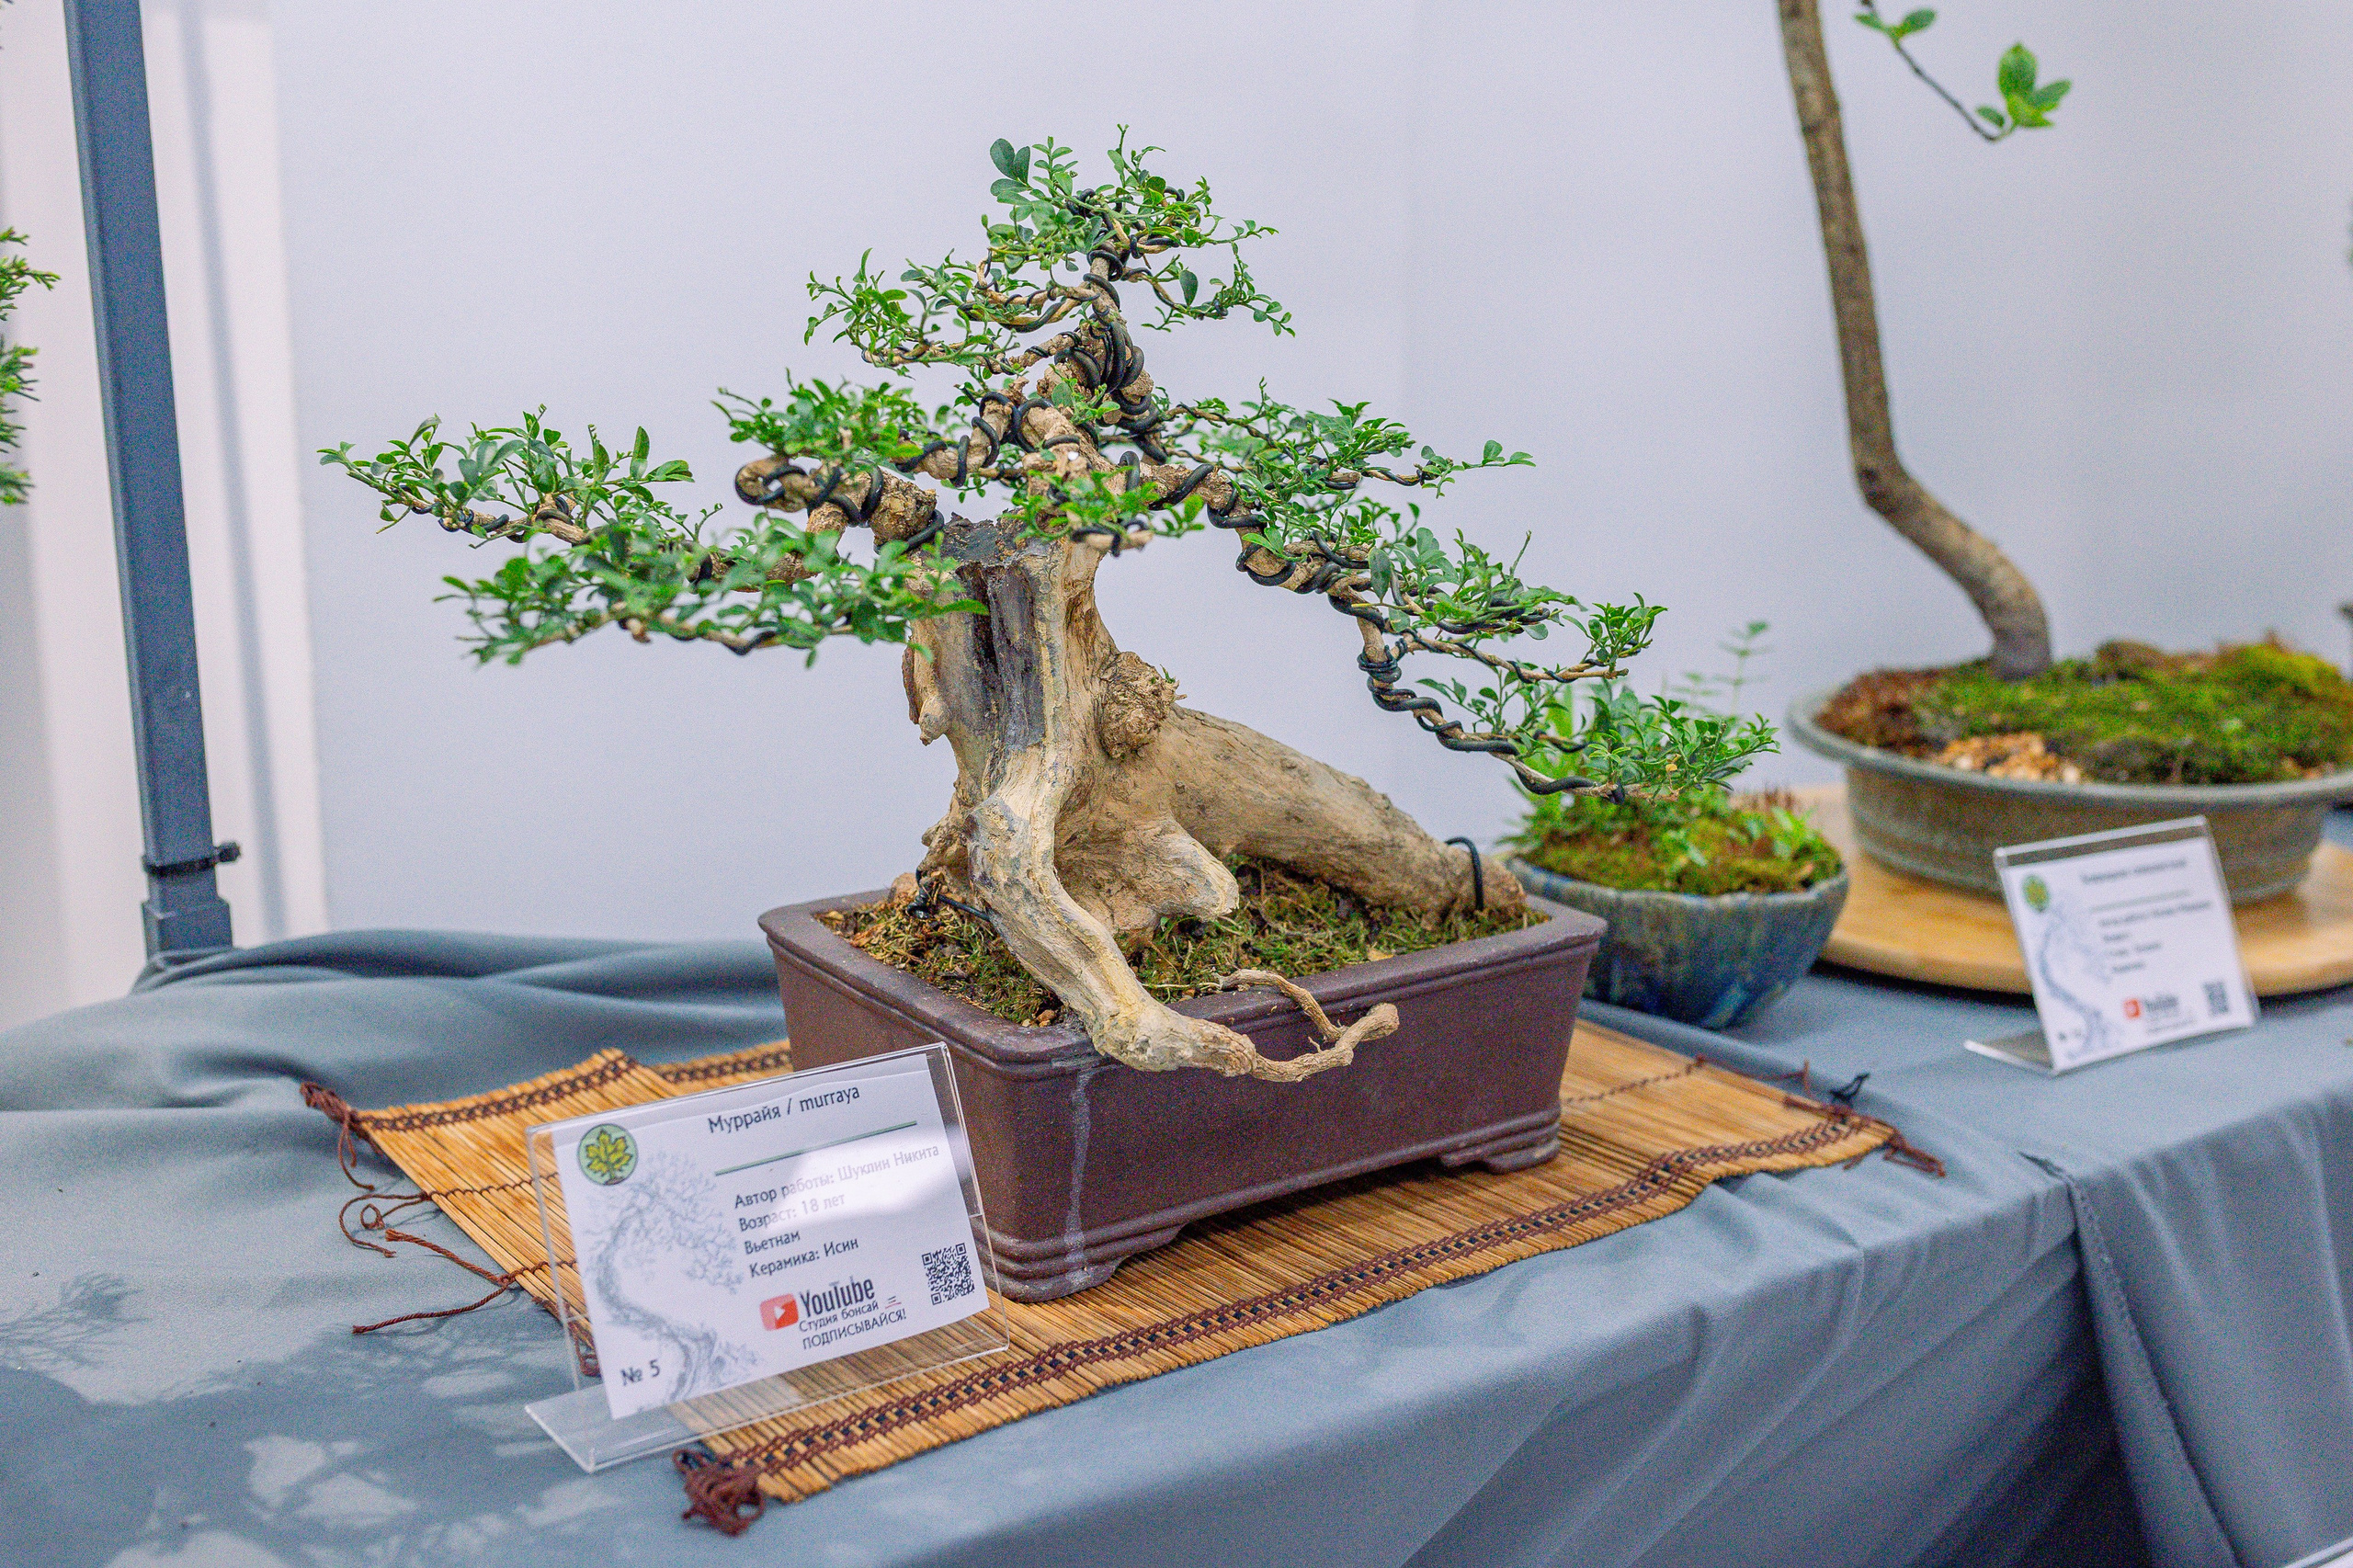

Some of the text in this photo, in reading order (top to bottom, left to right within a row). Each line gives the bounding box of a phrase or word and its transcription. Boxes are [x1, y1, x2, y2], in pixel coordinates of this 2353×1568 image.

[708, 1086, 860, 1134] Муррайя / murraya
[734, 1145, 939, 1210] Автор работы: Шуклин Никита
[738, 1193, 846, 1233] Возраст: 18 лет
[745, 1230, 801, 1255] Вьетнам
[749, 1237, 859, 1278] Керамика: Исин
[799, 1276, 875, 1318] YouTube
[799, 1300, 879, 1333] Студия бонсай
[802, 1309, 906, 1350] ПОДПИСЫВАЙСЯ!
[620, 1359, 660, 1386] № 5
